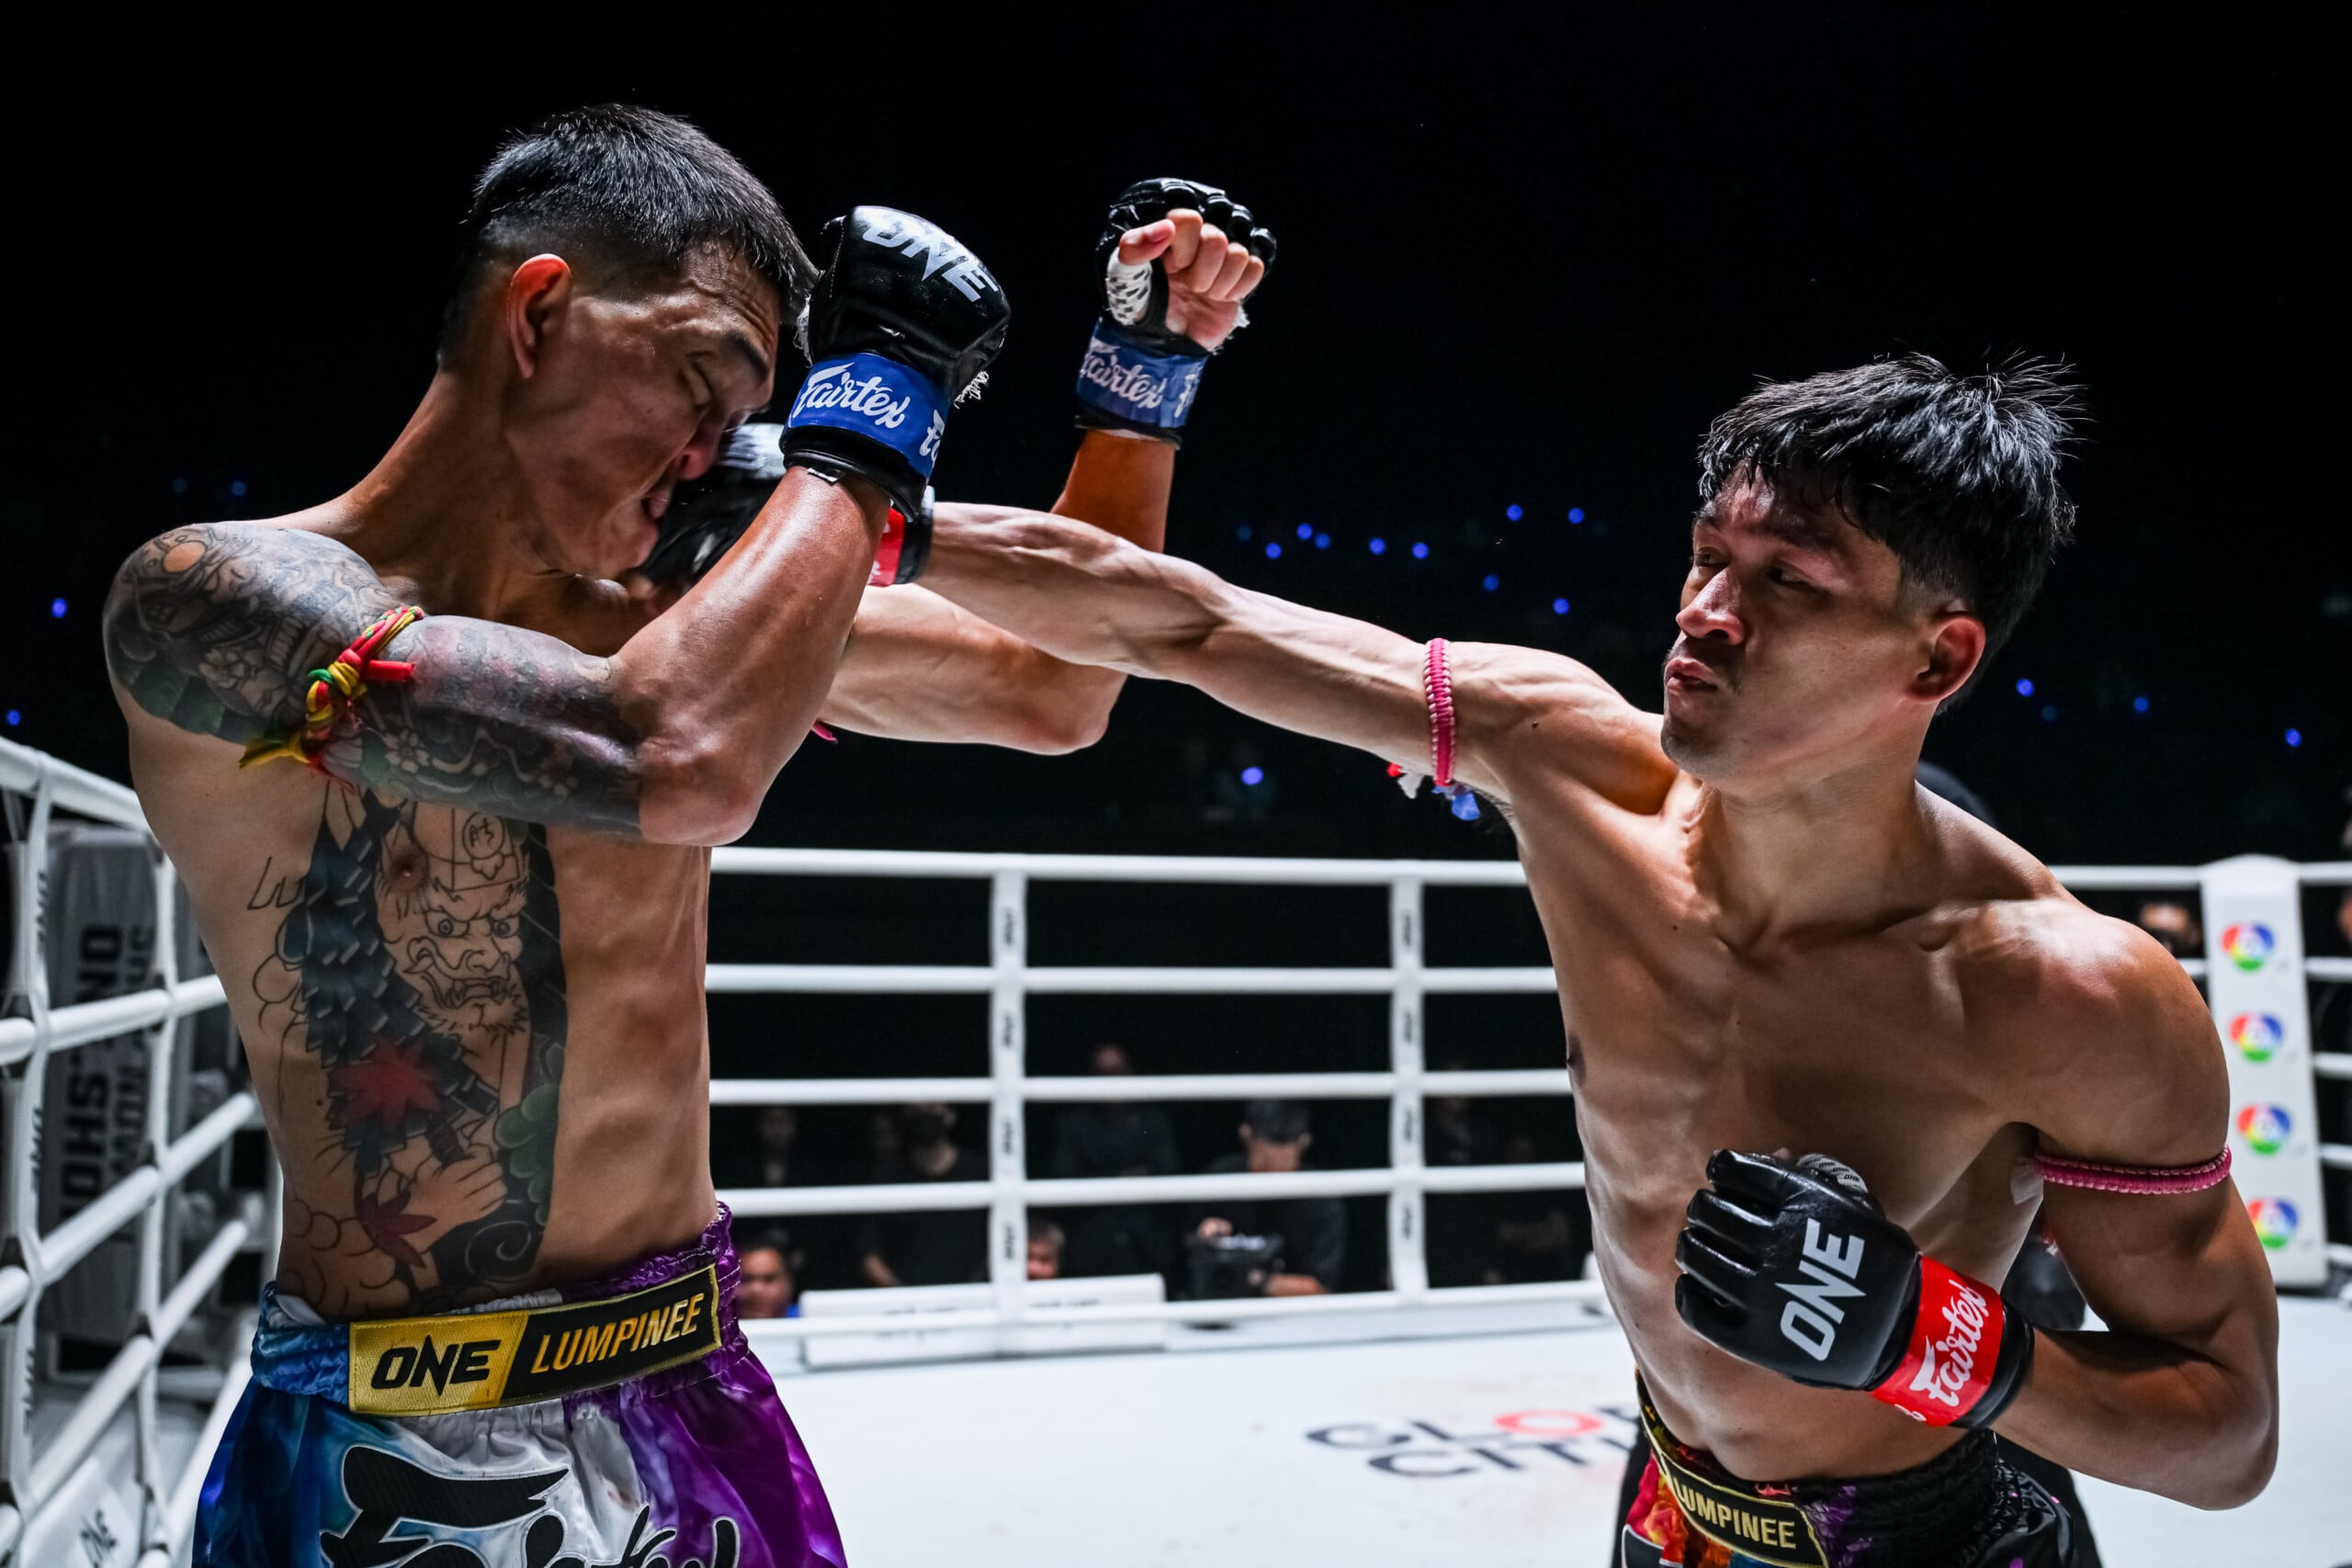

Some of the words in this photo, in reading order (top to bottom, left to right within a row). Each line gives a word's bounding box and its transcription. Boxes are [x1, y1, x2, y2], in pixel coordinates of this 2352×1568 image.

[862, 218, 999, 303] ONE
[791, 362, 910, 429] Fairtex
[1775, 1218, 1866, 1361] ONE
[370, 1335, 502, 1397] ONE
[530, 1292, 705, 1374] LUMPINEE
[1909, 1280, 1990, 1407] Fairtex
[1673, 1476, 1797, 1550] LUMPINEE
